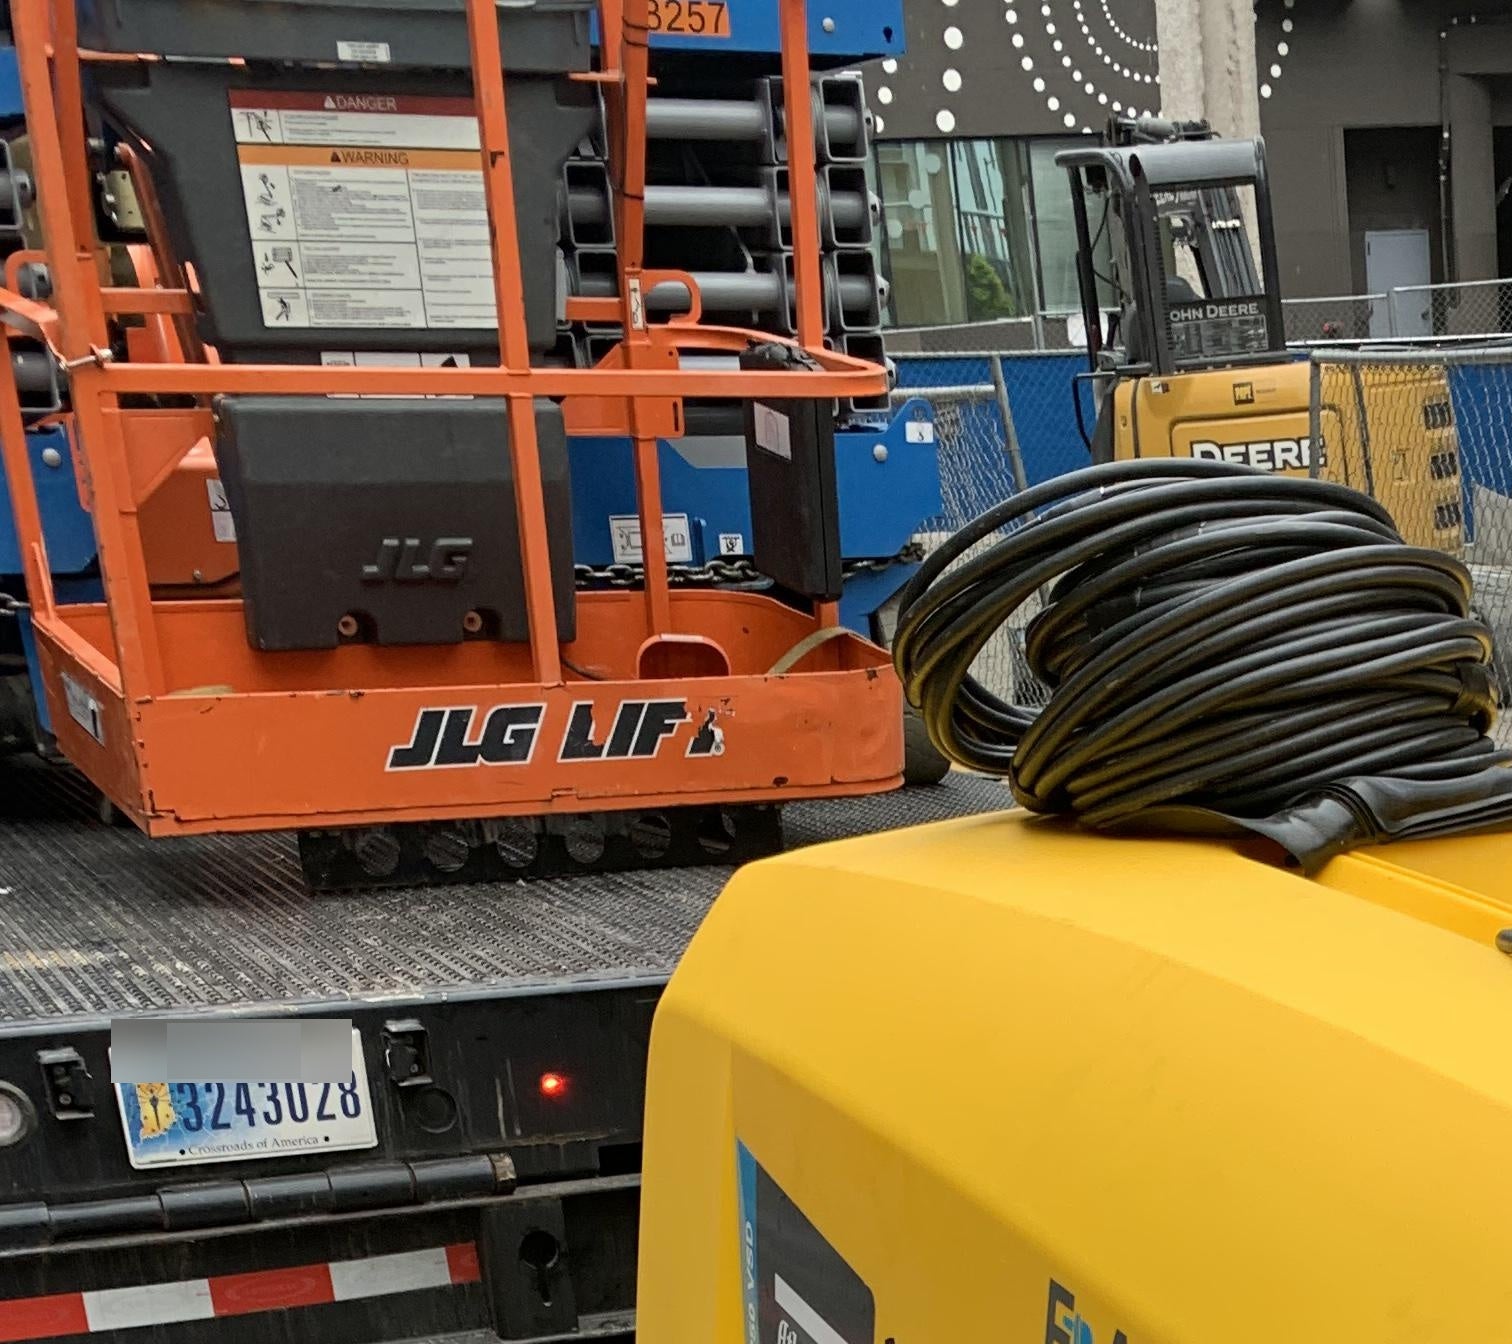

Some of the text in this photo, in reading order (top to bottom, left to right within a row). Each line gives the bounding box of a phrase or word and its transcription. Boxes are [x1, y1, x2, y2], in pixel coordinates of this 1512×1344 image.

[335, 95, 398, 111] DANGER
[341, 151, 409, 166] WARNING
[1206, 303, 1259, 318] DEERE
[361, 537, 473, 580] JLG
[385, 701, 547, 772] JLG
[188, 1134, 319, 1155] Crossroads of America
